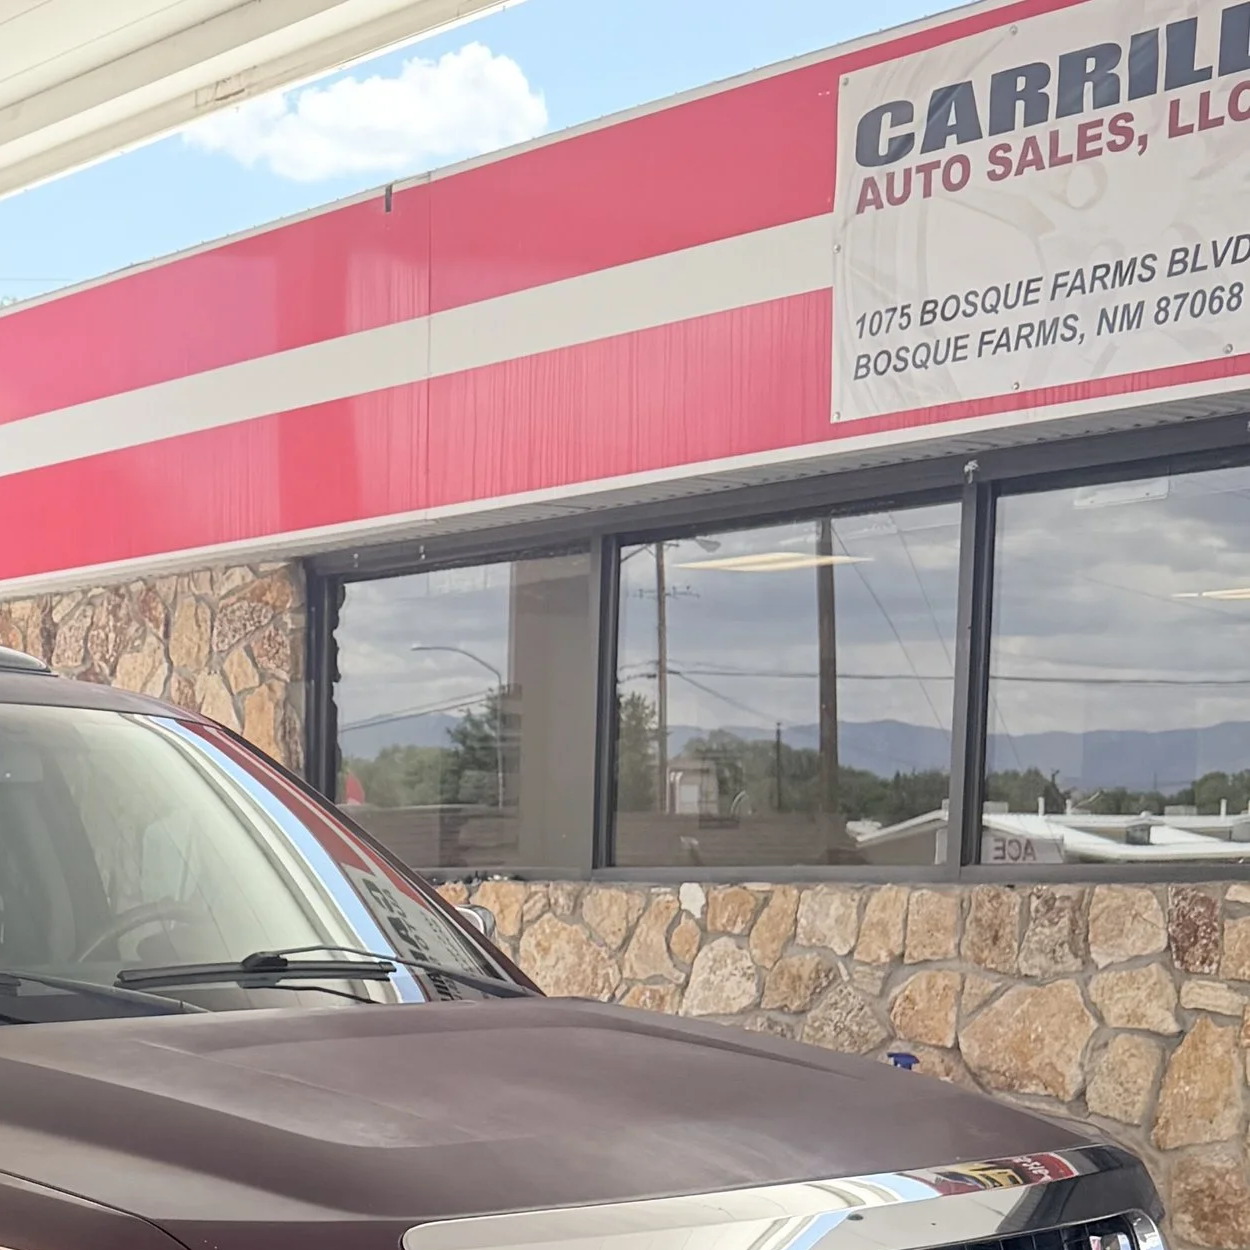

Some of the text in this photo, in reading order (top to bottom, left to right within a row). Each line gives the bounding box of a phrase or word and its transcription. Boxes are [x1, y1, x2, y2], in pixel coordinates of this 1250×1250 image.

[855, 1, 1250, 168] CARRILL
[855, 80, 1250, 214] AUTO SALES, LLC
[853, 281, 1244, 381] BOSQUE FARMS, NM 87068
[855, 233, 1250, 339] 1075 BOSQUE FARMS BLVD
